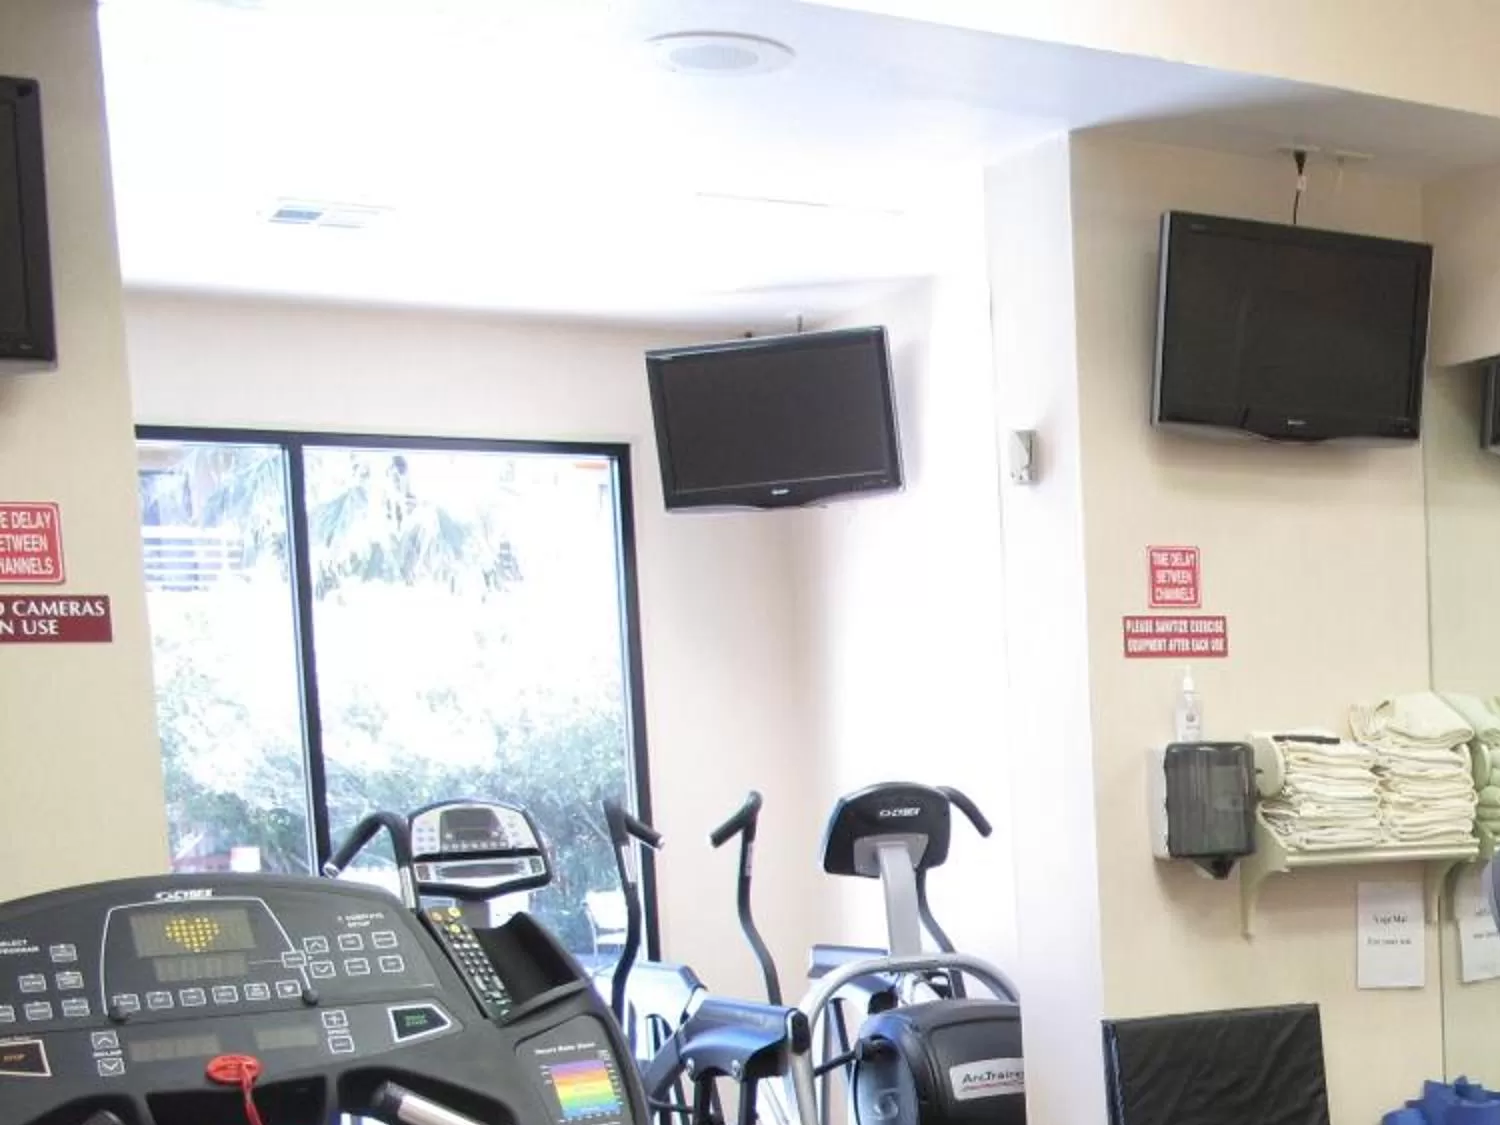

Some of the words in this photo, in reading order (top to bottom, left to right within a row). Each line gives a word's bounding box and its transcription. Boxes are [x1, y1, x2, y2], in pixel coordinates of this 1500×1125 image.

[11, 511, 50, 528] DELAY
[0, 534, 48, 551] ETWEEN
[0, 557, 53, 574] HANNELS
[12, 600, 105, 616] CAMERAS
[0, 620, 14, 635] N
[22, 620, 59, 635] USE
